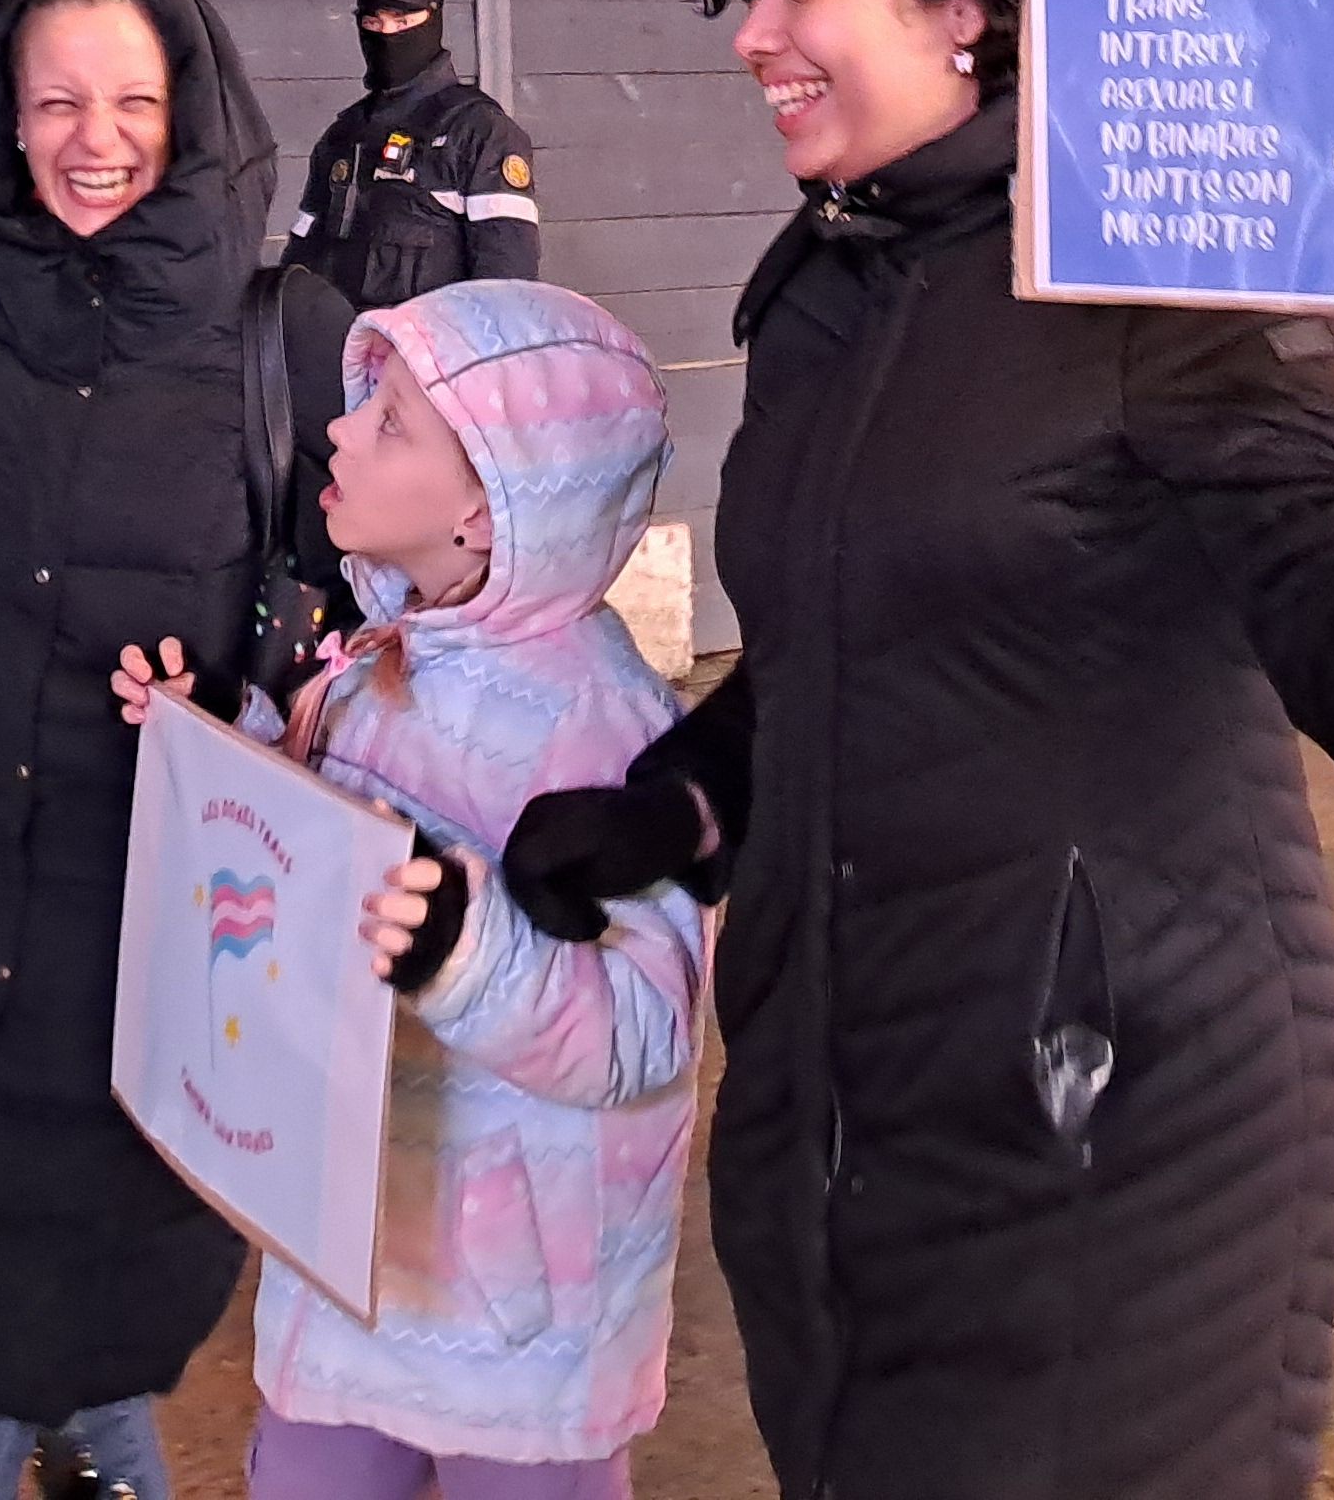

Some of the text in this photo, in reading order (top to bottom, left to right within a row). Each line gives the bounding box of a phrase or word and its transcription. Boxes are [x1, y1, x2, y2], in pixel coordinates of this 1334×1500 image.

[1100, 75, 1238, 113] ASEXUALS
[1100, 119, 1144, 158] NO
[1099, 162, 1223, 206] JUNTES
